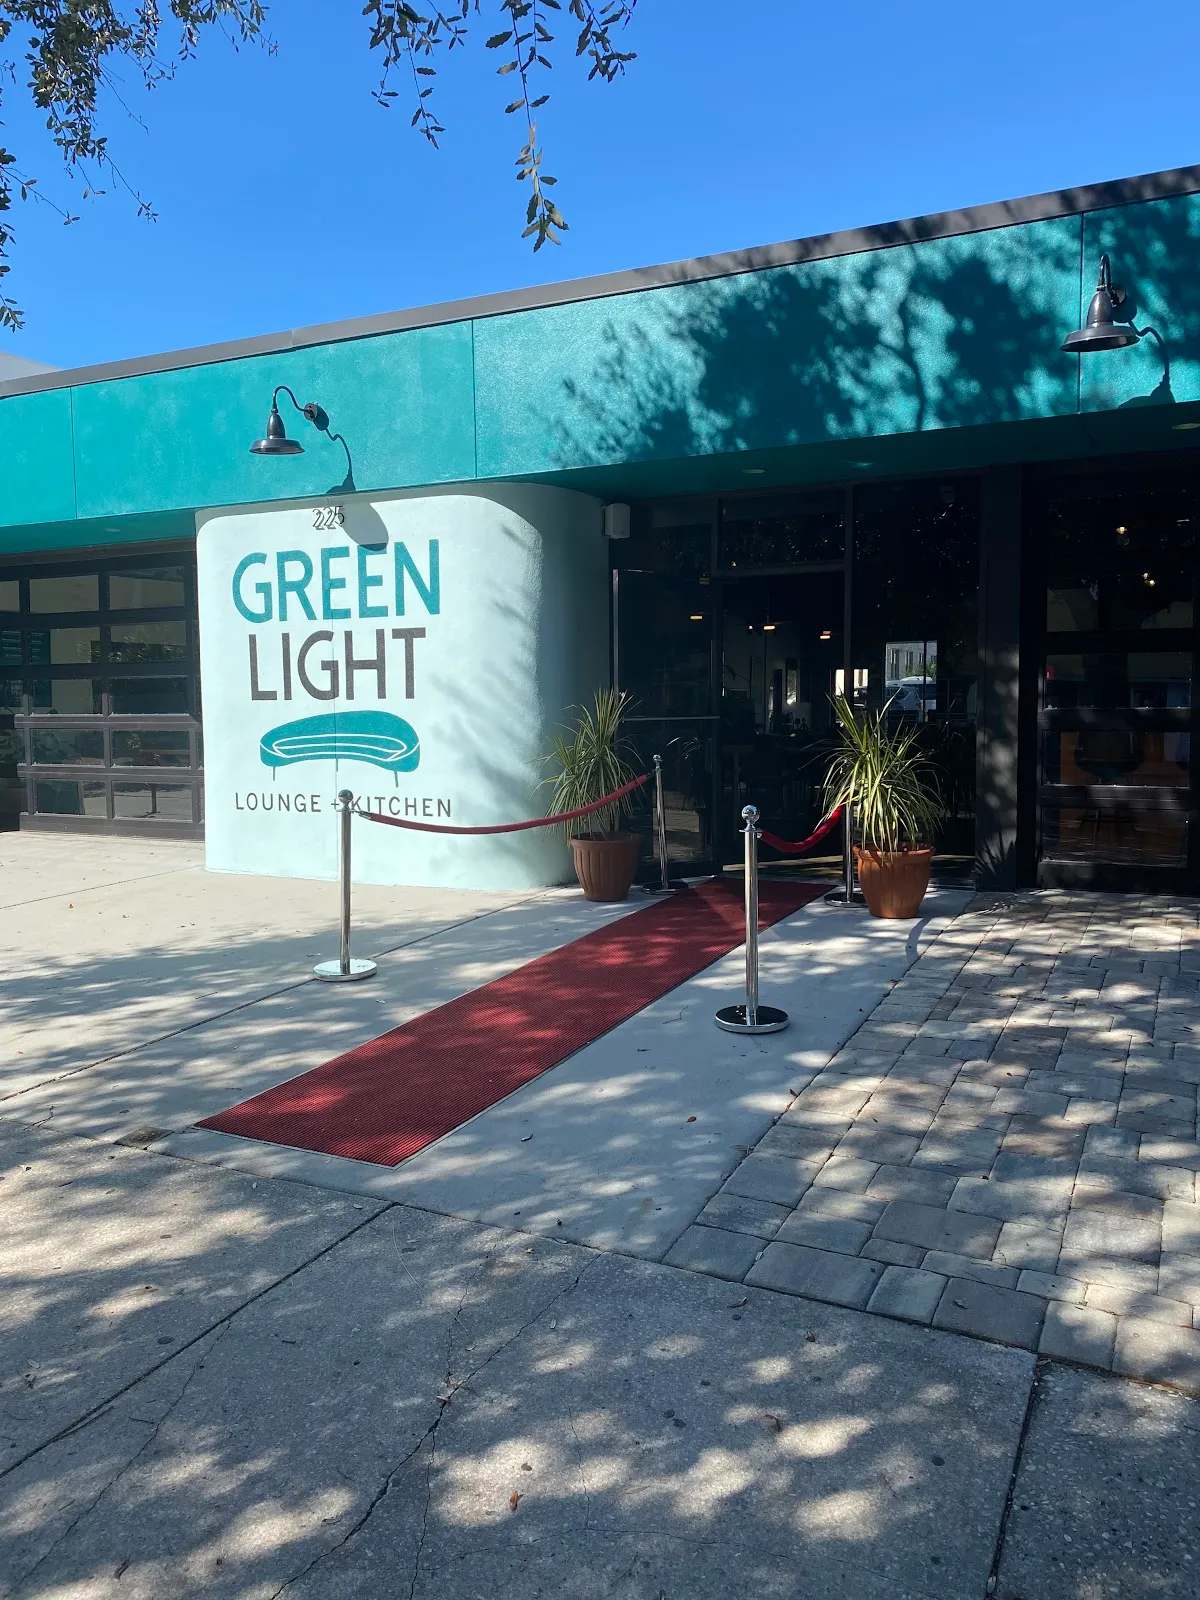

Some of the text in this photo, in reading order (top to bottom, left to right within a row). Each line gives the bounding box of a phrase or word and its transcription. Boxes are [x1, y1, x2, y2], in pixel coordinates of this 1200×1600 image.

[312, 505, 345, 530] 225
[232, 539, 440, 624] GREEN
[248, 627, 426, 701] LIGHT
[235, 792, 322, 813] LOUNGE
[351, 796, 452, 818] KITCHEN
